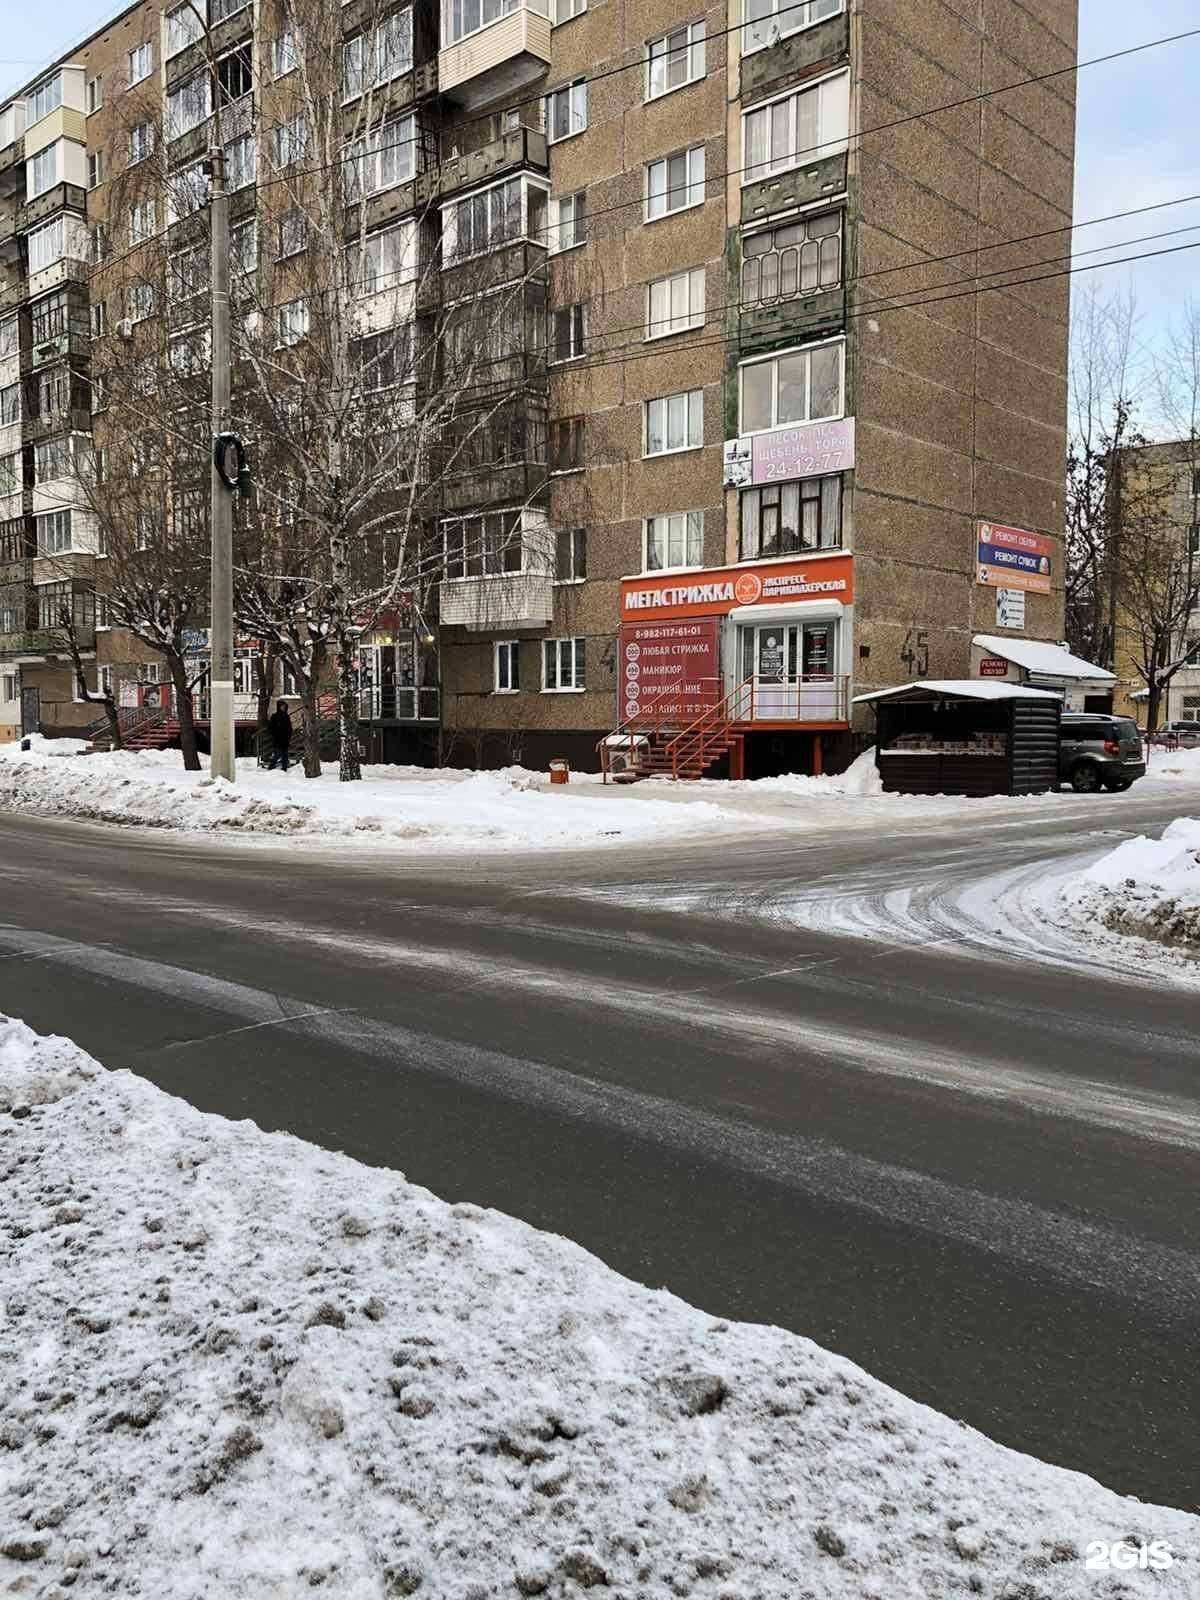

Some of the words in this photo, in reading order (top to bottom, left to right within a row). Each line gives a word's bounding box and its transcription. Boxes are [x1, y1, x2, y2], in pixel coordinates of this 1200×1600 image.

[759, 445, 808, 461] ЩЕБЕНЬ
[815, 437, 848, 450] ТОРФ
[766, 451, 843, 479] 24-12-77
[762, 574, 807, 587] ЭКСПРЕСС
[762, 579, 847, 597] ПАРИКМАХЕРСКАЯ
[624, 581, 736, 610] МЕГАСТРИЖКА
[643, 646, 670, 656] ЛЮБАЯ
[671, 644, 709, 655] СТРИЖКА
[900, 630, 929, 676] 45
[643, 665, 682, 675] МАНИКЮР
[642, 684, 701, 695] ОКРАШИВНИЕ
